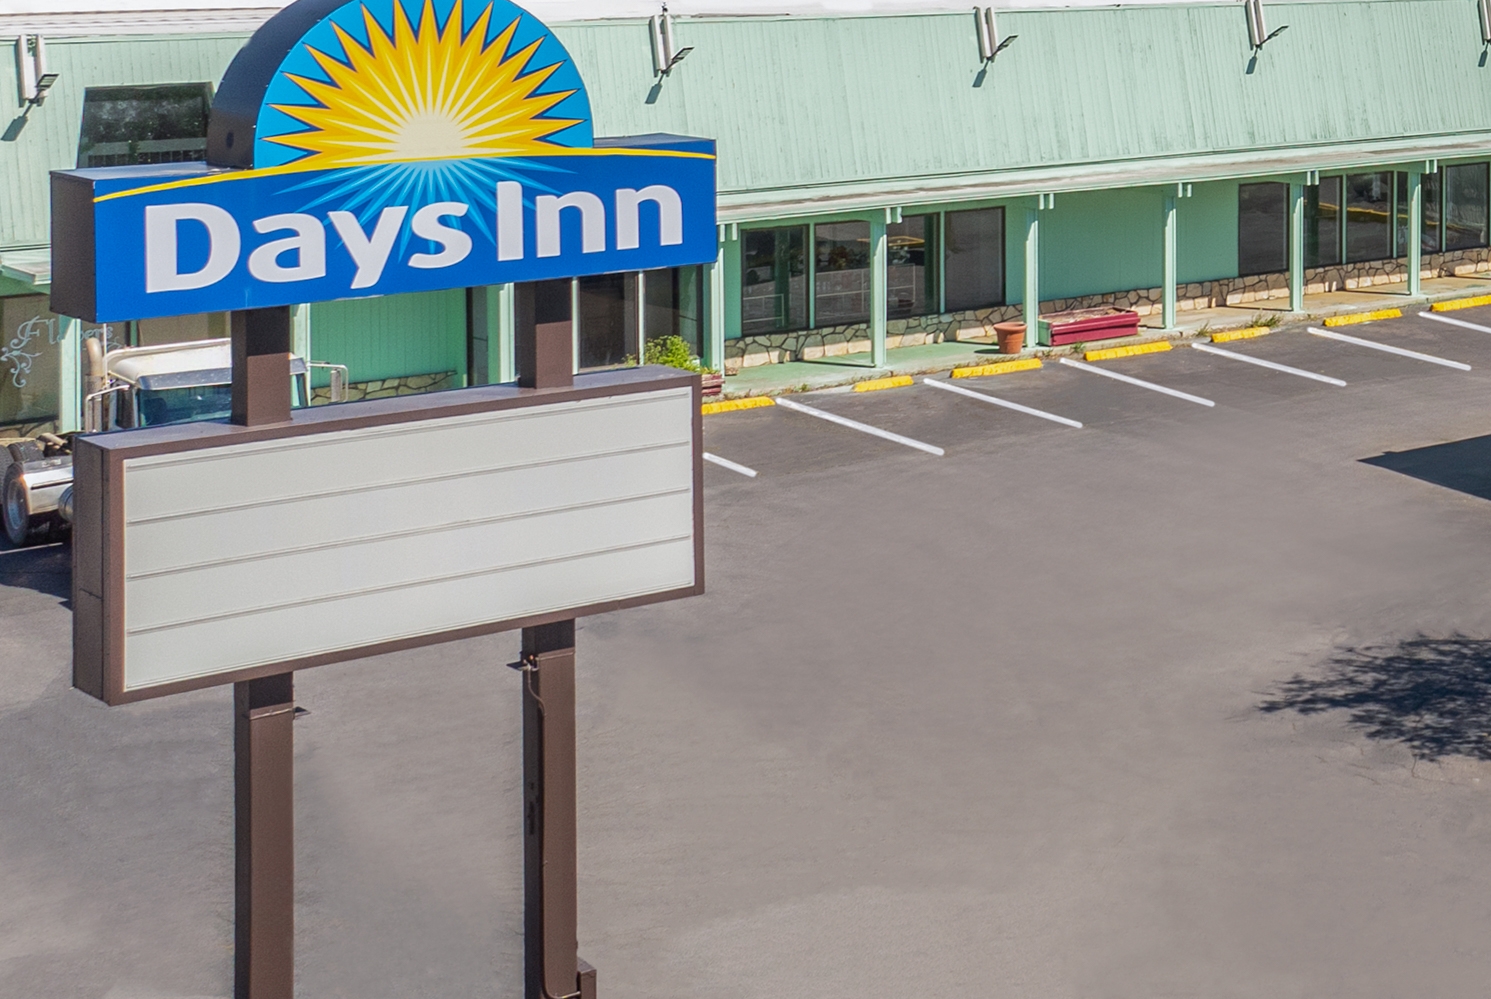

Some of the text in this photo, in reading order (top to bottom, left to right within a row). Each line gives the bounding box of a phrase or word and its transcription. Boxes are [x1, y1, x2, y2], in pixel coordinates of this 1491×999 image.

[145, 180, 683, 294] Days Inn
[10, 315, 114, 349] Flers
